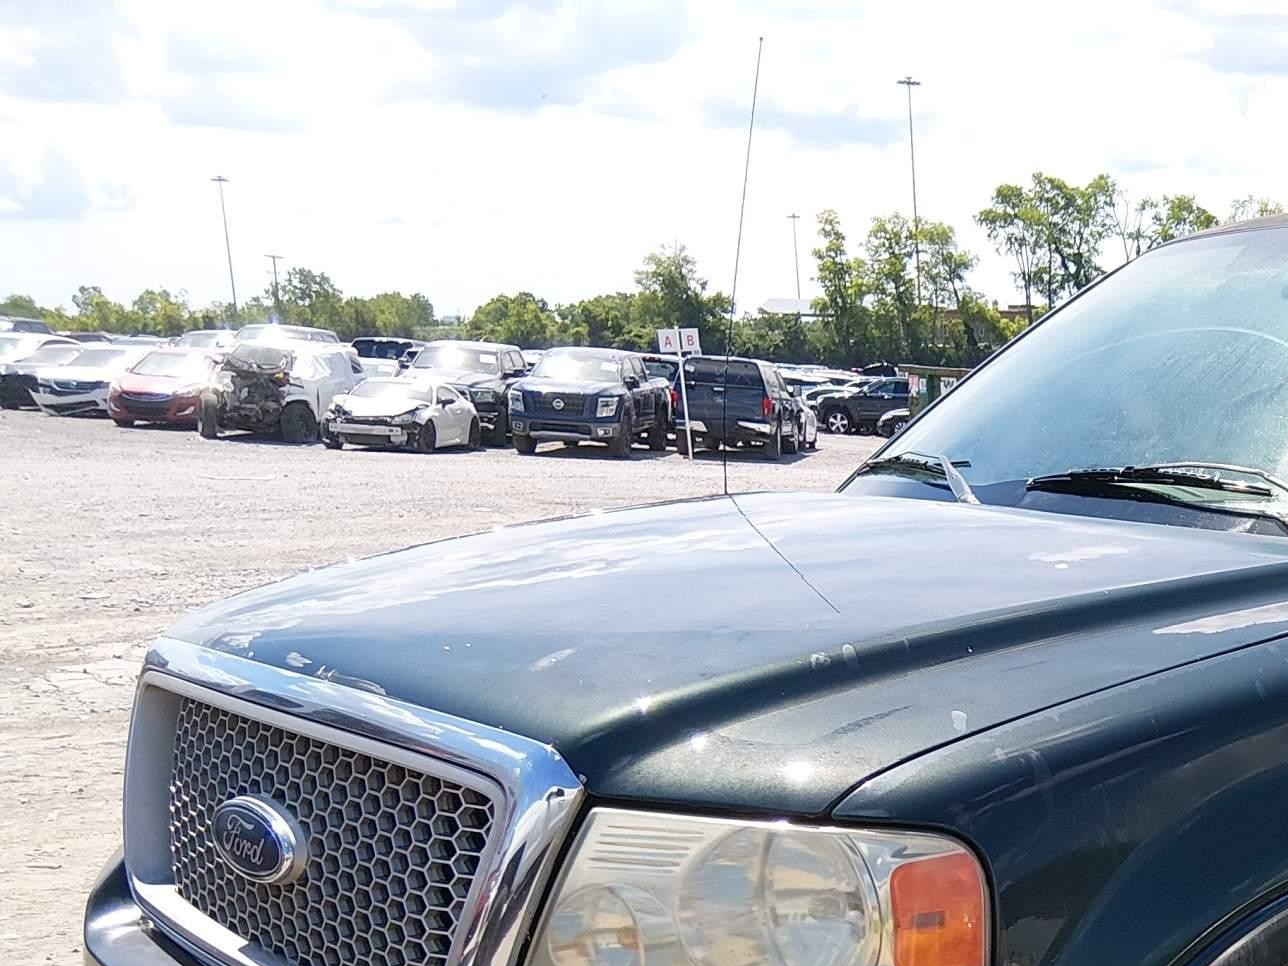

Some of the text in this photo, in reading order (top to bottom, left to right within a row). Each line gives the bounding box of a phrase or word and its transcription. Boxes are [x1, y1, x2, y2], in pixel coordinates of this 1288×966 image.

[664, 335, 672, 348] A
[686, 334, 695, 346] B
[223, 814, 264, 865] Ford
